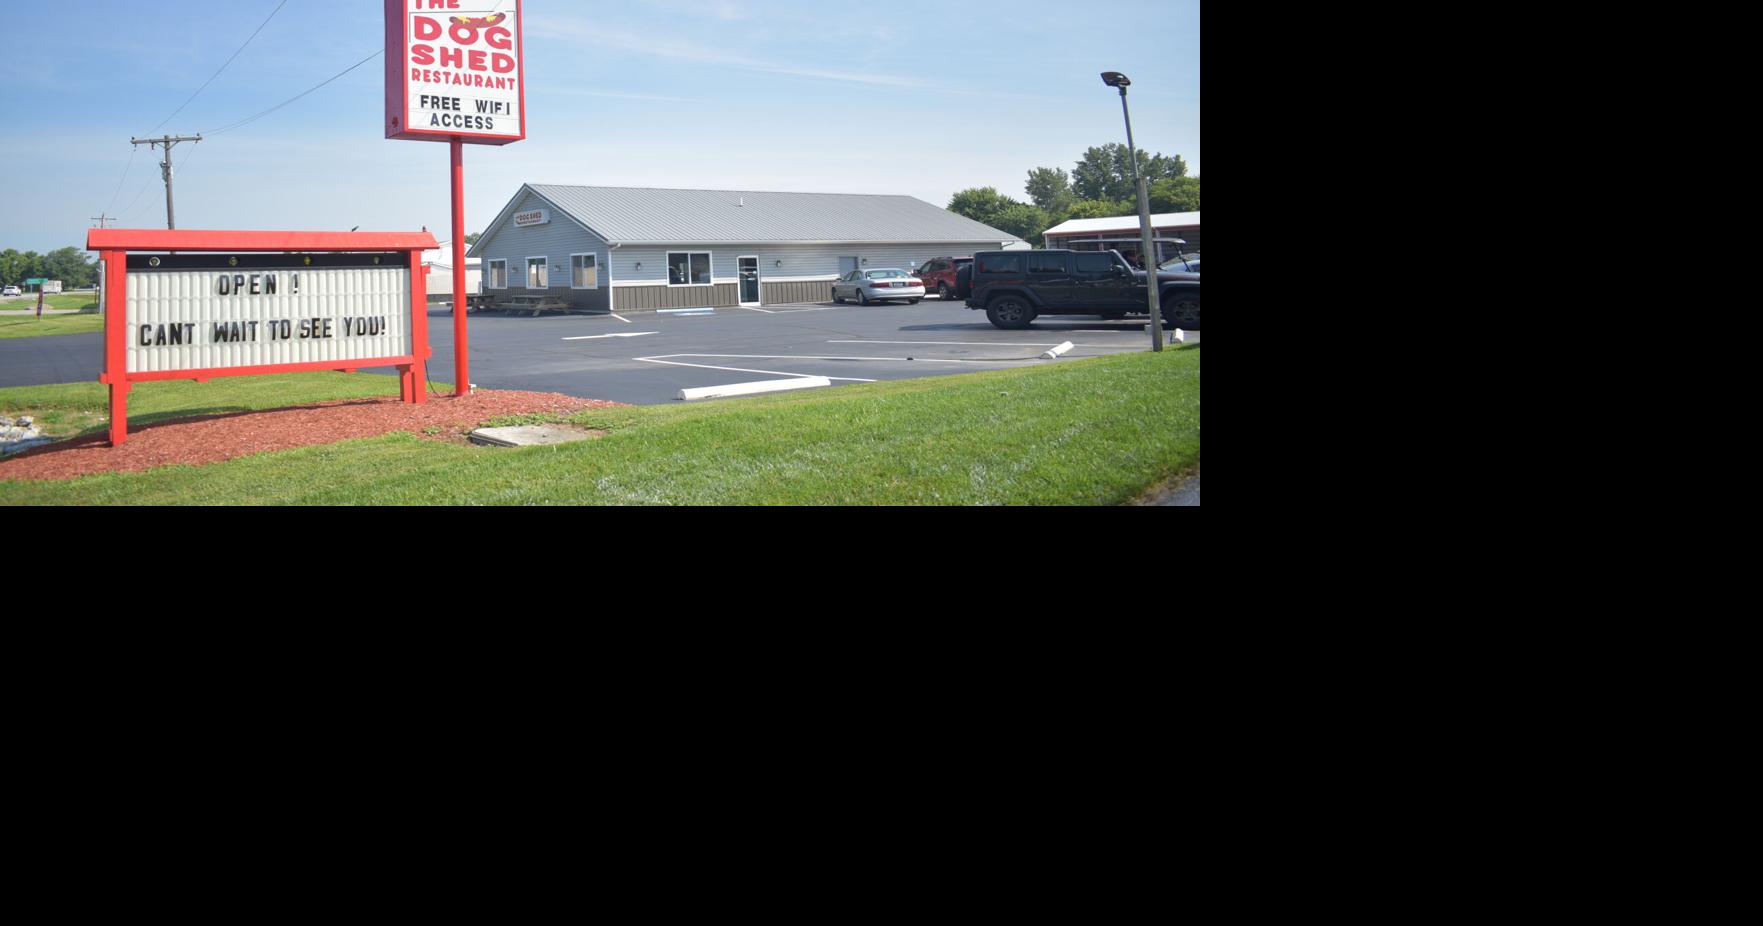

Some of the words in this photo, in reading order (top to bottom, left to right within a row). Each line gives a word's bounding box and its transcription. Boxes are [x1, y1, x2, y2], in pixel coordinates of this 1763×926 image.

[413, 15, 512, 51] DOG
[411, 44, 515, 73] SHED
[411, 68, 515, 90] RESTAURANT
[420, 95, 461, 111] FREE
[475, 99, 510, 115] WIFI
[430, 113, 494, 130] ACCESS
[218, 274, 277, 295] OPEN
[140, 322, 195, 346] CANT
[213, 321, 259, 343] WAIT
[269, 319, 291, 341] TO
[300, 318, 333, 339] SEE
[343, 316, 386, 337] YOU!
